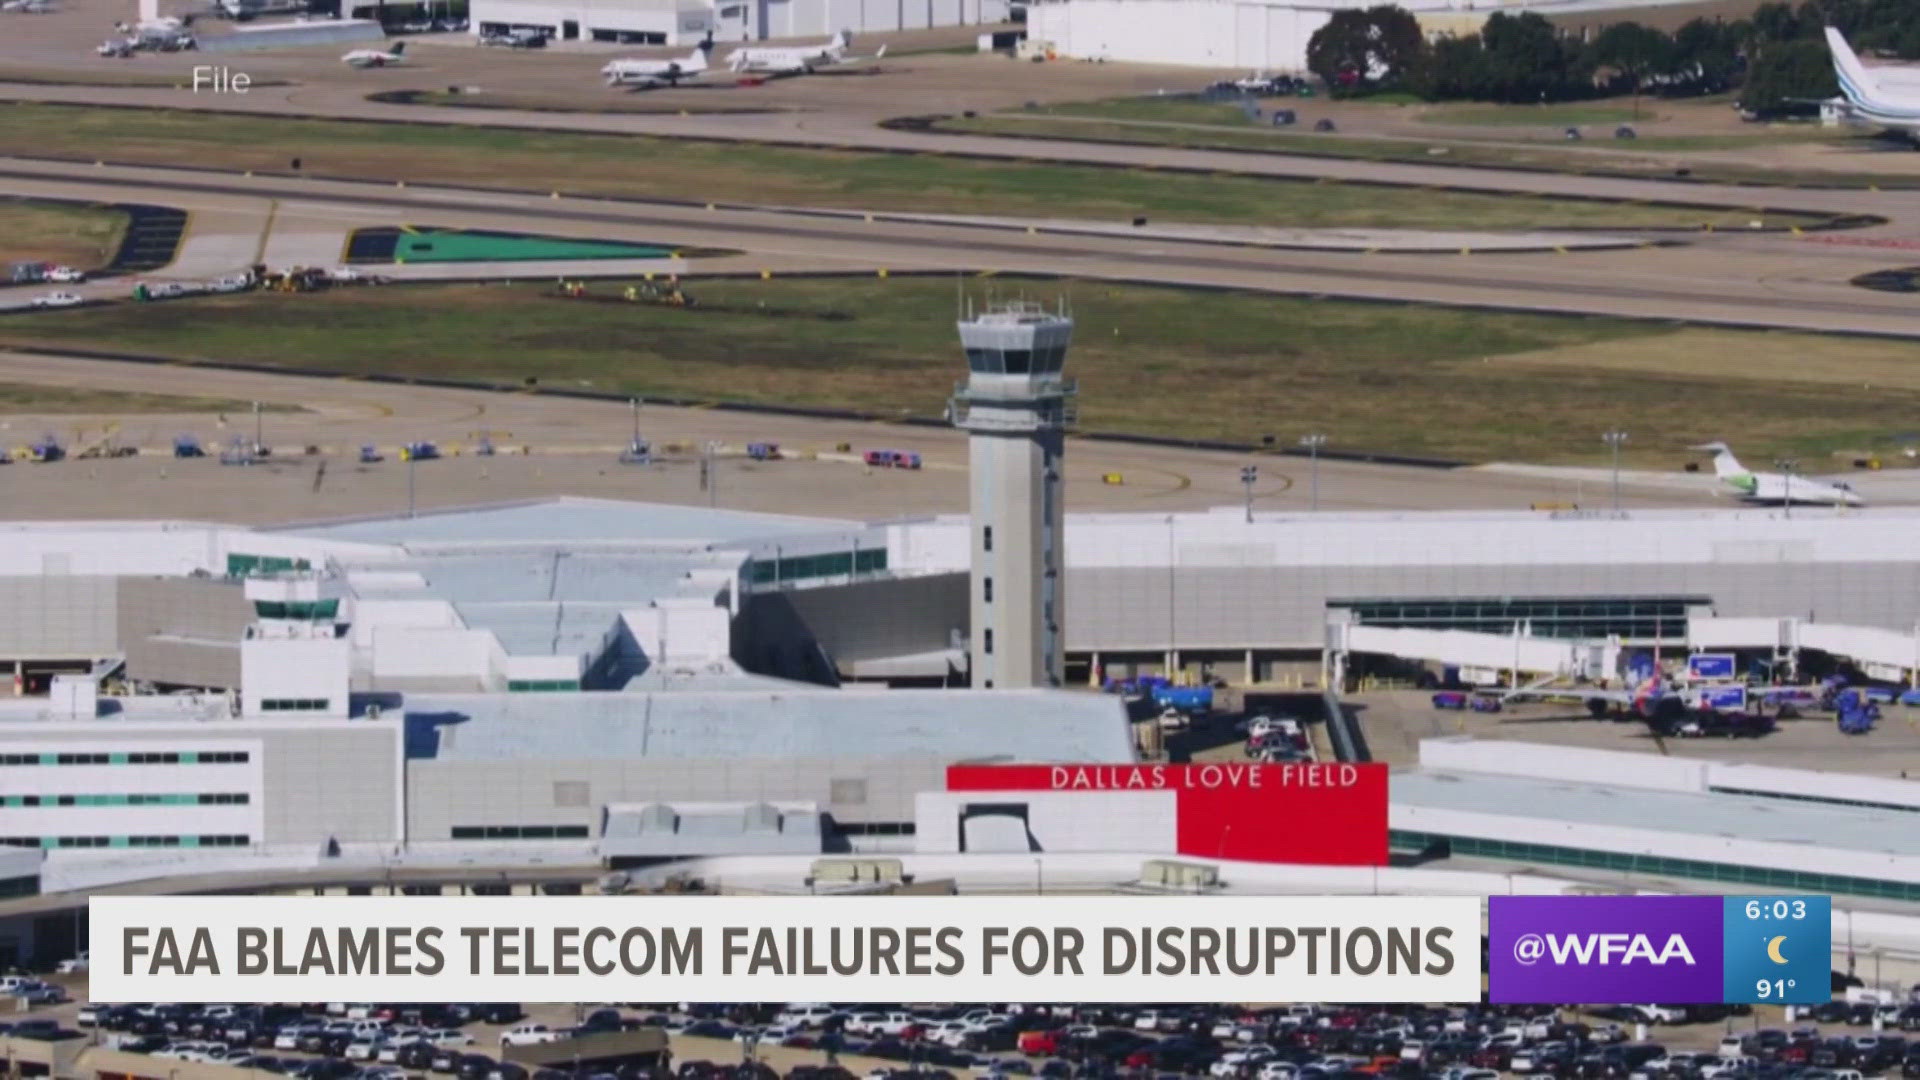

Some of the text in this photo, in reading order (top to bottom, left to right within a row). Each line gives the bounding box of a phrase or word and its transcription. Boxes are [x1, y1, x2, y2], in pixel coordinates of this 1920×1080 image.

[1052, 764, 1358, 790] DALLAS LOVE FIELD
